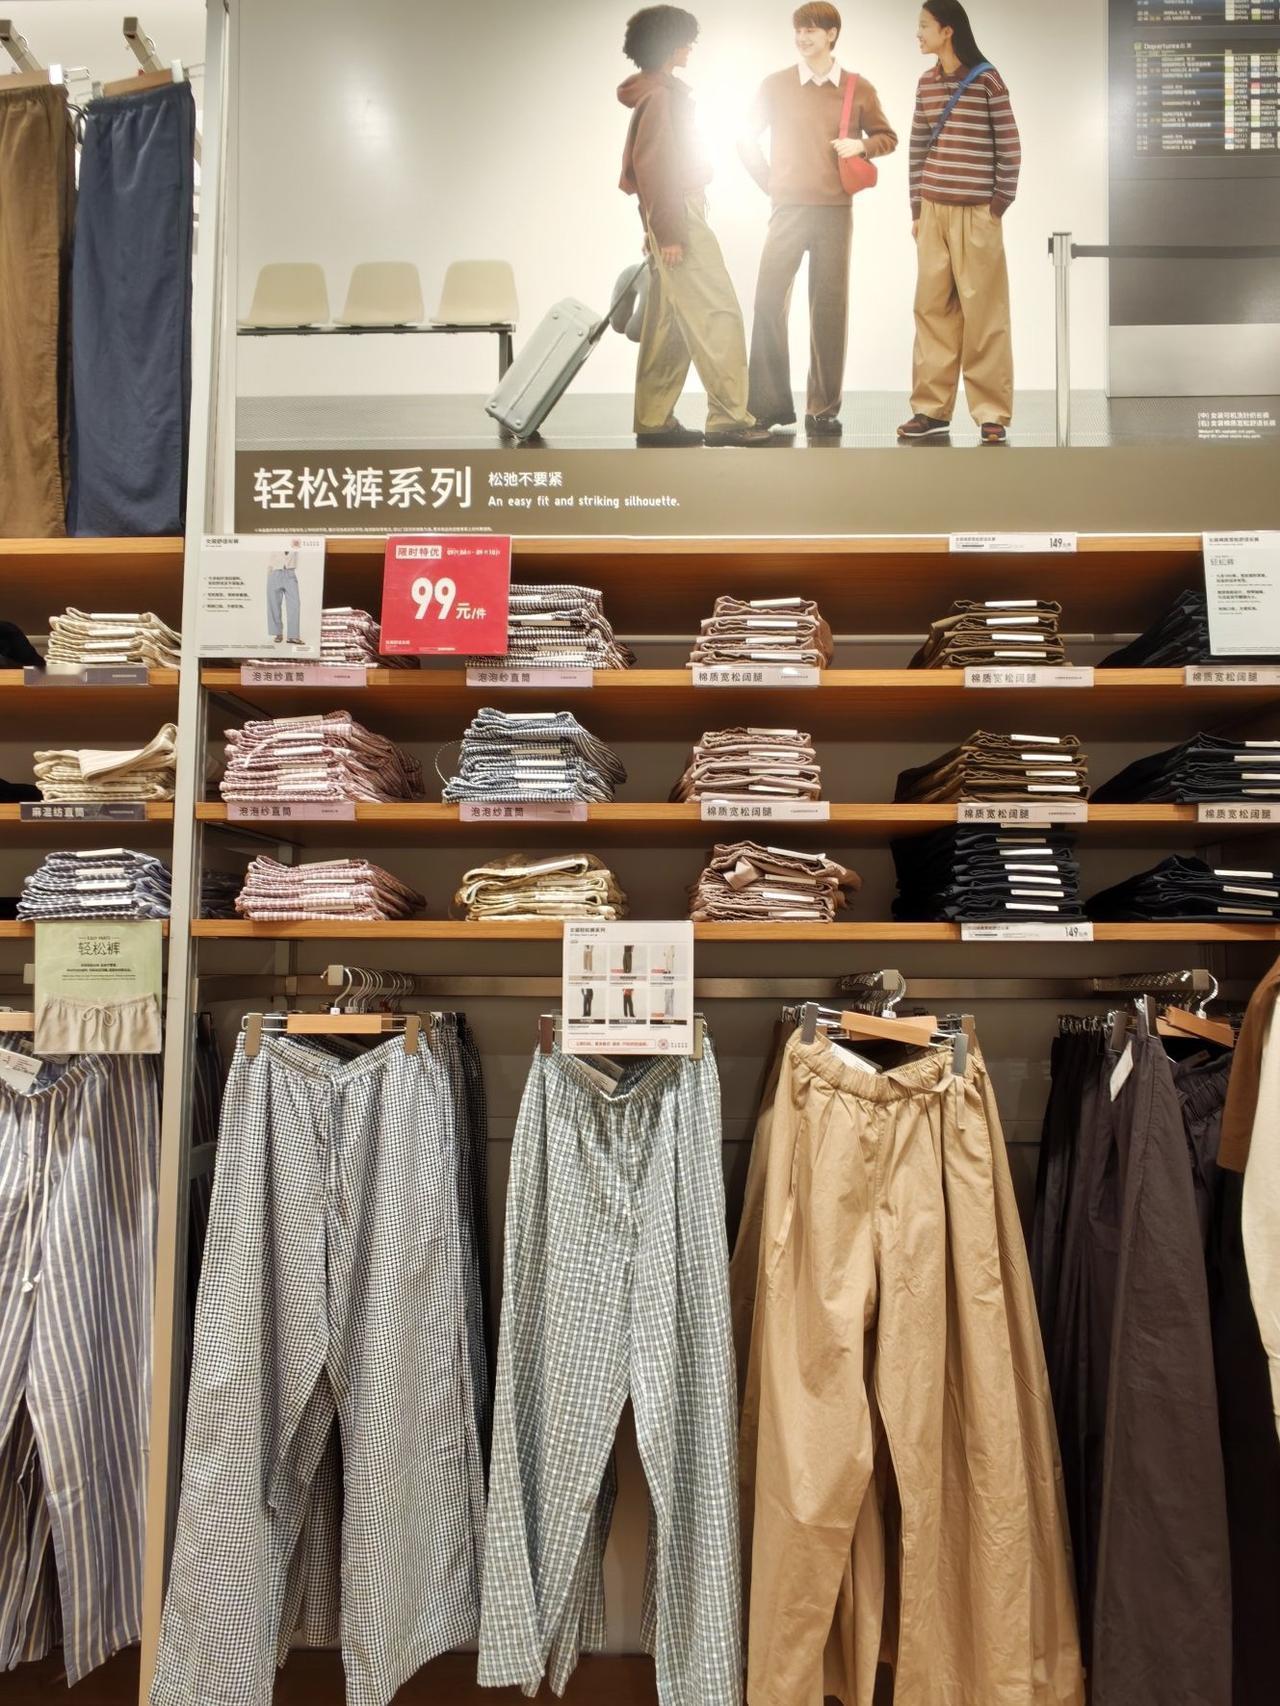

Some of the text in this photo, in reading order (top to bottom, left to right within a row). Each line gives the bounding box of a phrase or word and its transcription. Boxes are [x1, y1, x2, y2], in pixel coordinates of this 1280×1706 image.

[488, 471, 563, 487] 松弛不要紧
[253, 466, 472, 510] 轻松裤系列
[488, 496, 681, 509] An easy fit and striking silhouette.
[397, 546, 440, 558] 限时特优
[251, 671, 305, 682] 泡泡纱直筒
[478, 672, 531, 683] 泡泡纱直筒
[699, 672, 763, 682] 棉质宽松阔腿
[239, 806, 292, 817] 泡泡纱直筒
[471, 806, 524, 817] 泡泡纱直筒
[707, 806, 773, 817] 棉质宽松阔腿
[964, 809, 1030, 819] 棉质宽松阔腿
[1205, 809, 1271, 819] 棉质宽松阔腿
[78, 941, 121, 956] 轻松裤
